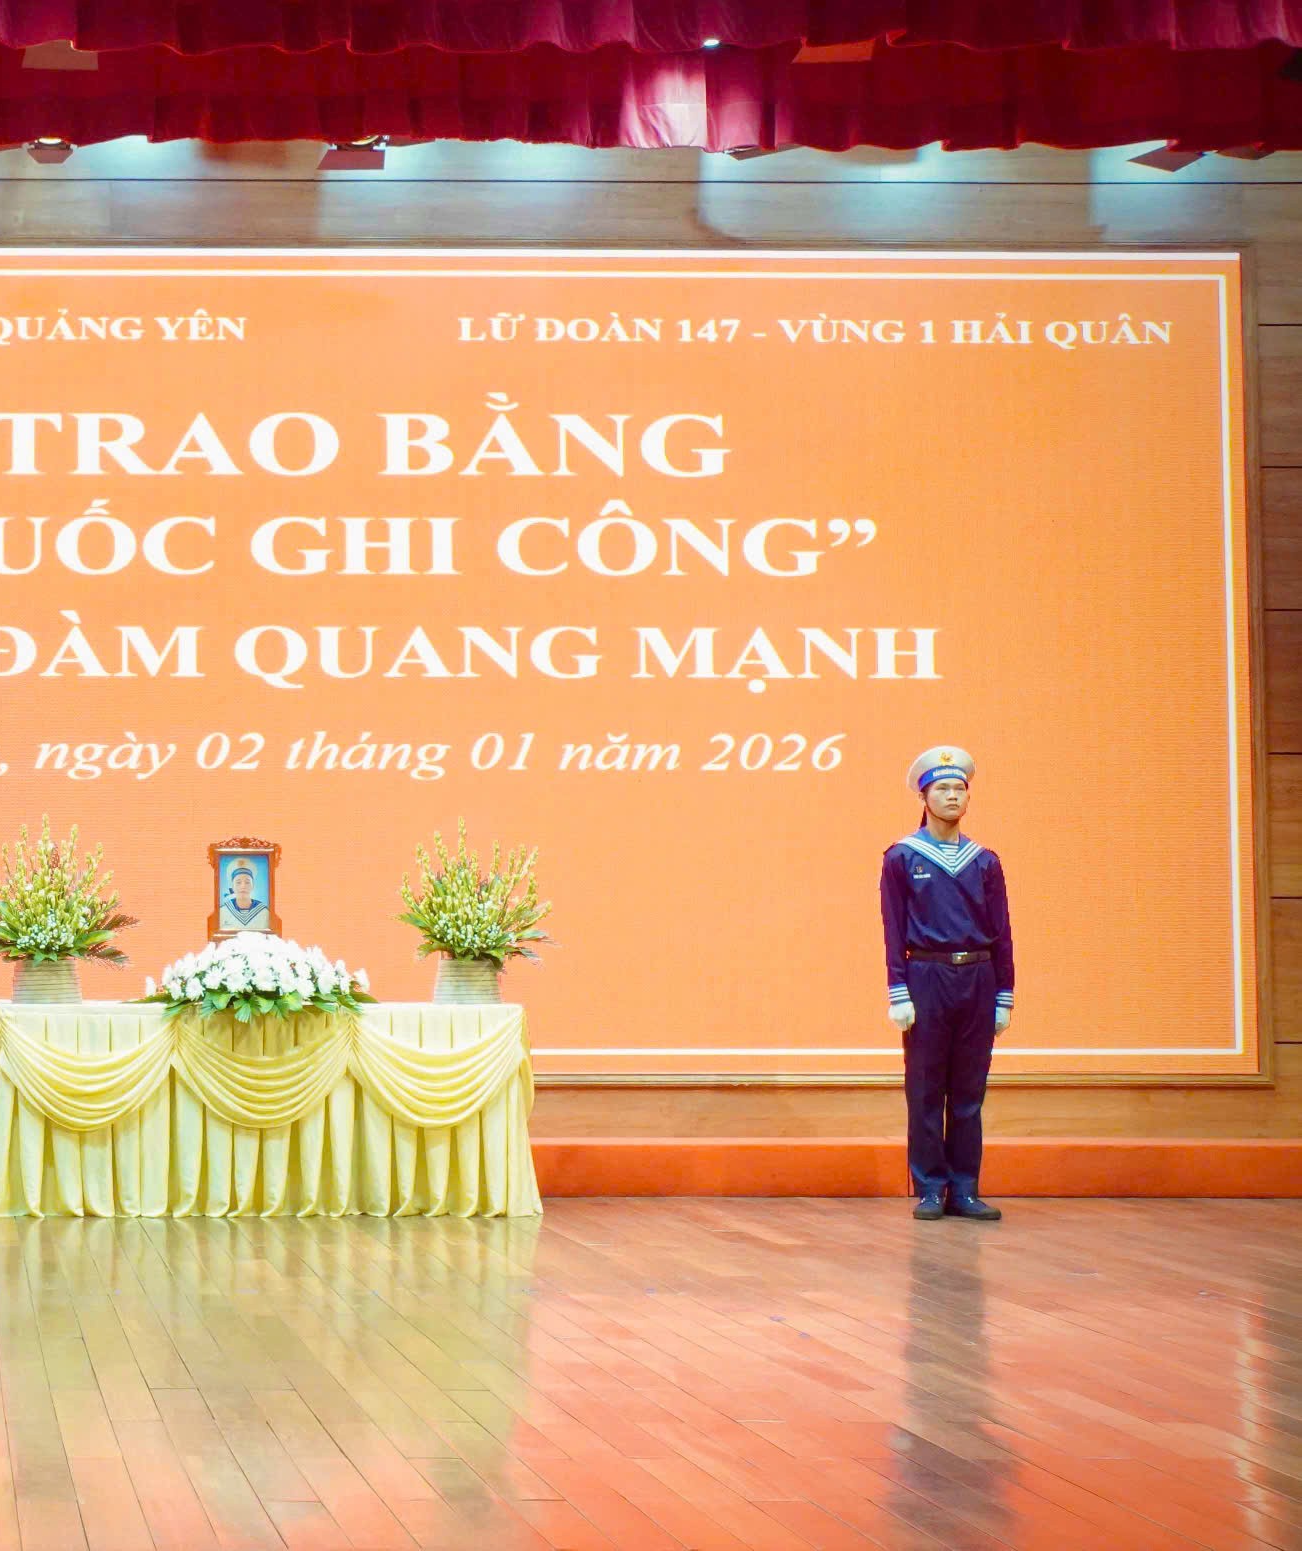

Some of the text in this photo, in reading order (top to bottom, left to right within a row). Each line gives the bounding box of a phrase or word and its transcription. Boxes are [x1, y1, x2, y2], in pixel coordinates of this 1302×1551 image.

[153, 307, 248, 342] YÊN
[456, 312, 526, 343] LỮ
[534, 312, 664, 343] ĐOÀN
[676, 318, 741, 343] 147
[777, 313, 906, 344] VÙNG
[919, 319, 936, 344] 1
[950, 313, 1032, 344] HẢI
[1043, 312, 1173, 350] QUÂN
[380, 391, 732, 479] BẰNG
[249, 515, 462, 577] GHI
[496, 498, 877, 578] CÔNG”
[234, 624, 603, 690] QUANG
[630, 625, 943, 694] MẠNH
[34, 731, 179, 781] ngày
[195, 731, 267, 771] 02
[284, 731, 452, 781] tháng
[469, 731, 535, 772] 01
[557, 732, 683, 772] năm
[700, 732, 847, 772] 2026
